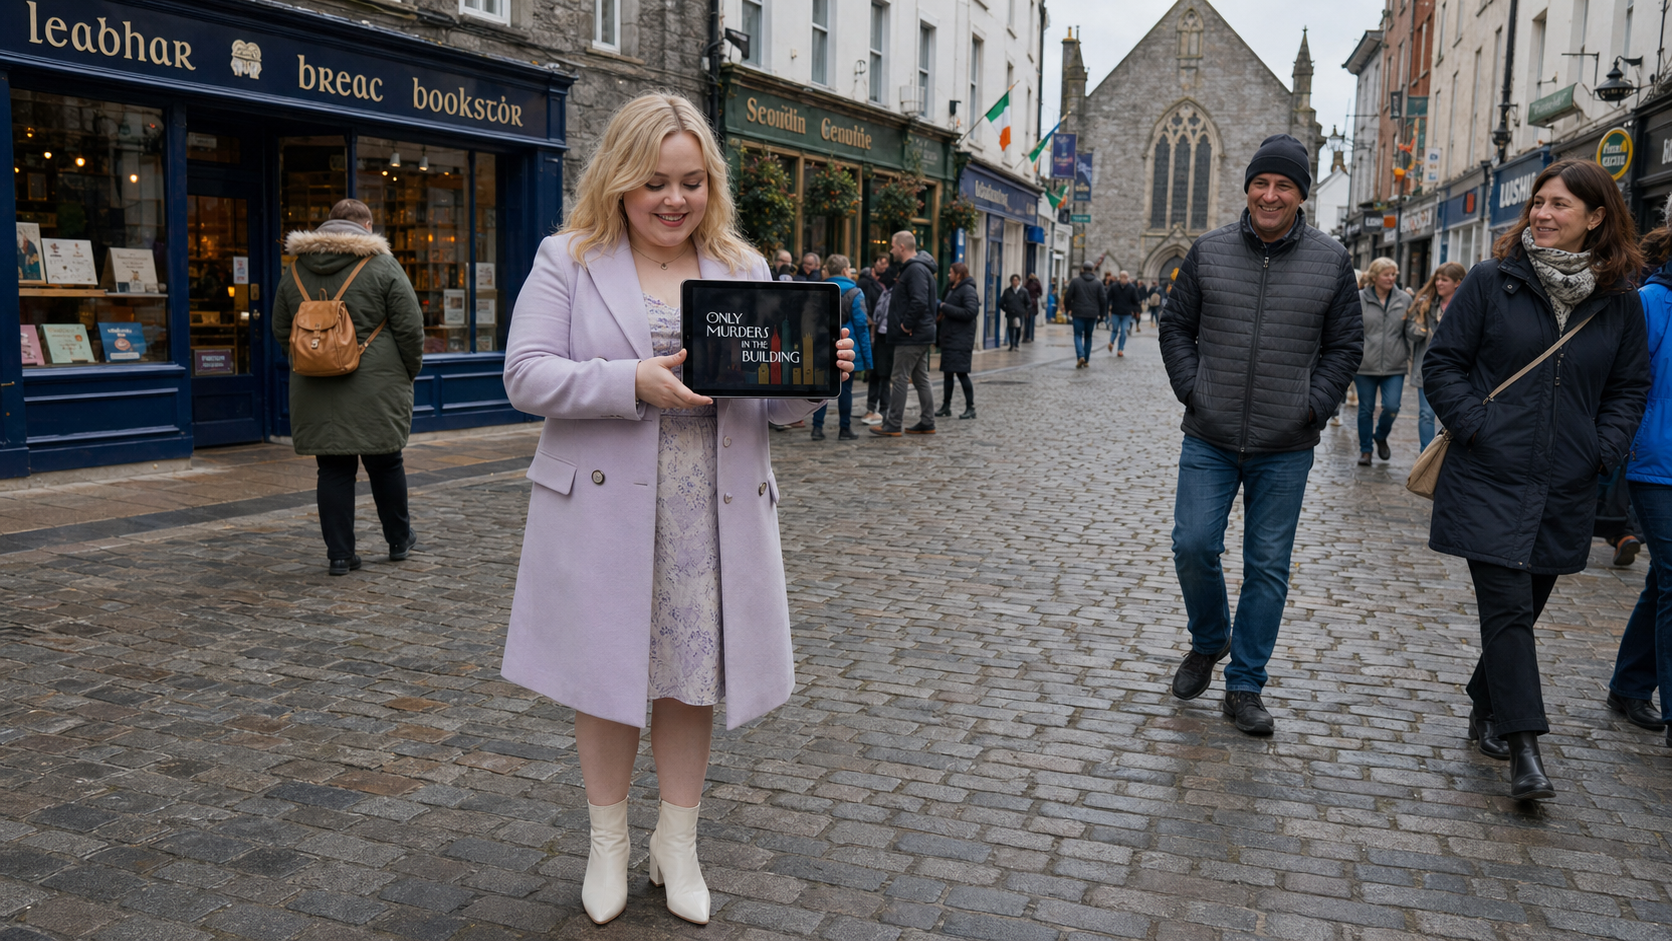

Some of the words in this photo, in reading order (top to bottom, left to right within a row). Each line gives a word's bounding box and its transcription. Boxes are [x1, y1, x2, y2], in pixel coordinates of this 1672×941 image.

[26, 1, 196, 71] leabhar
[297, 54, 384, 102] breac
[706, 311, 743, 325] ONLY
[706, 325, 770, 339] MURDERS
[741, 340, 751, 349] IN
[751, 340, 768, 349] THE
[742, 350, 800, 364] BUILDING
